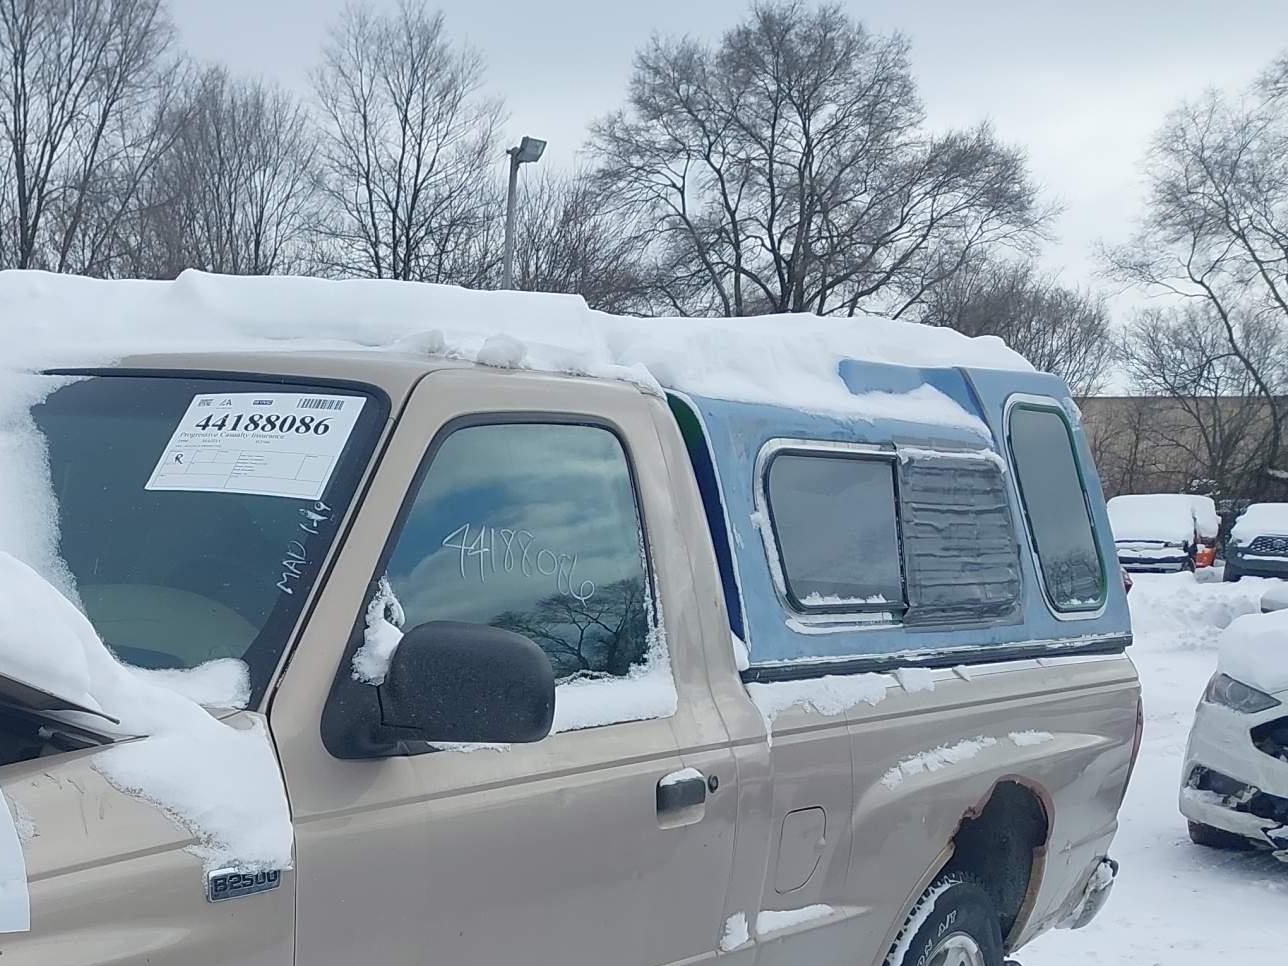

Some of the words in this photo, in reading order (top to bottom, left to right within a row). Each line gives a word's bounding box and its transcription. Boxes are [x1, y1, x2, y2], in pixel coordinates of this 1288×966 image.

[195, 413, 334, 436] 44188086
[442, 523, 595, 608] 44188086
[213, 869, 279, 893] B2500
